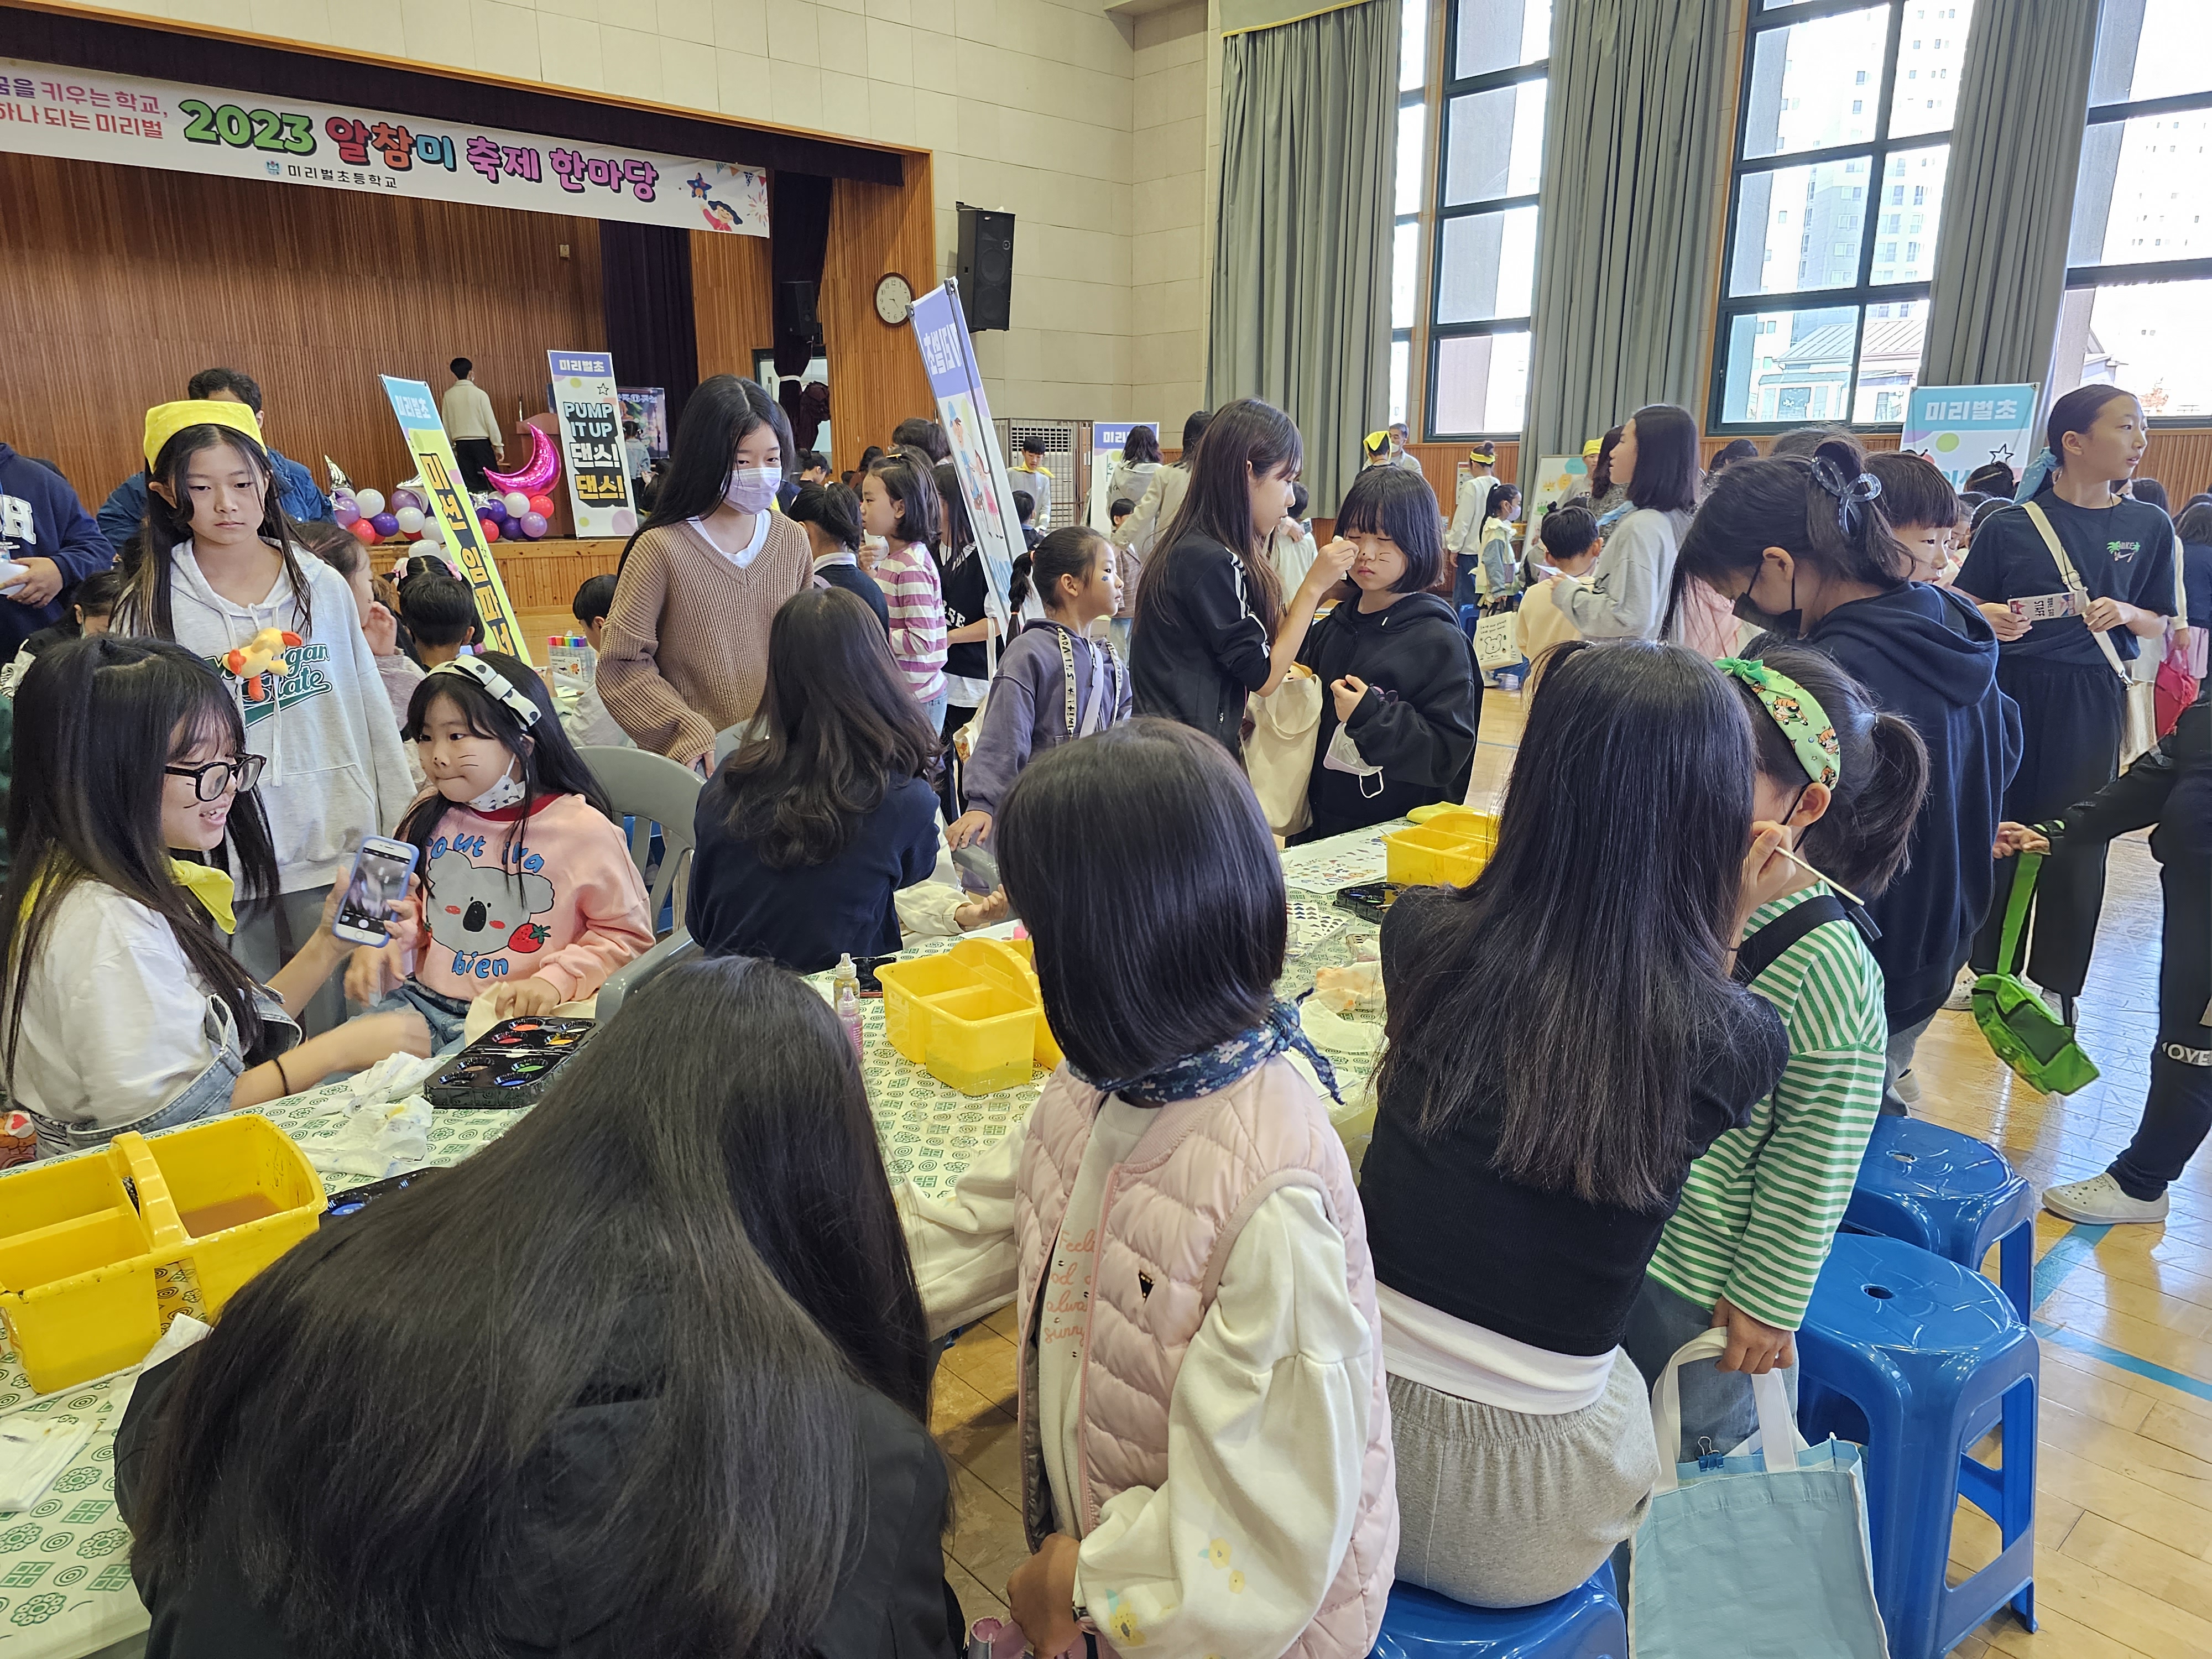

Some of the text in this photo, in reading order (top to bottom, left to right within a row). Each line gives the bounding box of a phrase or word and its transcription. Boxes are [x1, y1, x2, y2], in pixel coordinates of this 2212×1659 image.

[40, 82, 111, 108] 키우는
[114, 91, 168, 118] 학교,
[44, 107, 90, 130] 되는
[95, 113, 163, 139] 미리벌
[178, 99, 659, 202] 2023 알참미 축제 한마당
[288, 165, 397, 188] 미리벌초등학교
[559, 359, 605, 372] 미리벌초
[395, 395, 431, 419] 미리벌초
[564, 402, 613, 418] PUMP
[1924, 399, 2018, 421] 미리벌초
[570, 421, 613, 437] IT UP
[1103, 431, 1130, 444] 미리
[570, 442, 620, 468] 댄스!
[420, 453, 468, 531] 미션
[575, 474, 625, 499] 댄스!
[2034, 601, 2045, 617] STAFF
[425, 833, 486, 859] out
[451, 950, 509, 979] bien
[2162, 1042, 2212, 1067] OVE
[1046, 1289, 1088, 1313] alwa
[1044, 1325, 1084, 1348] sunny
